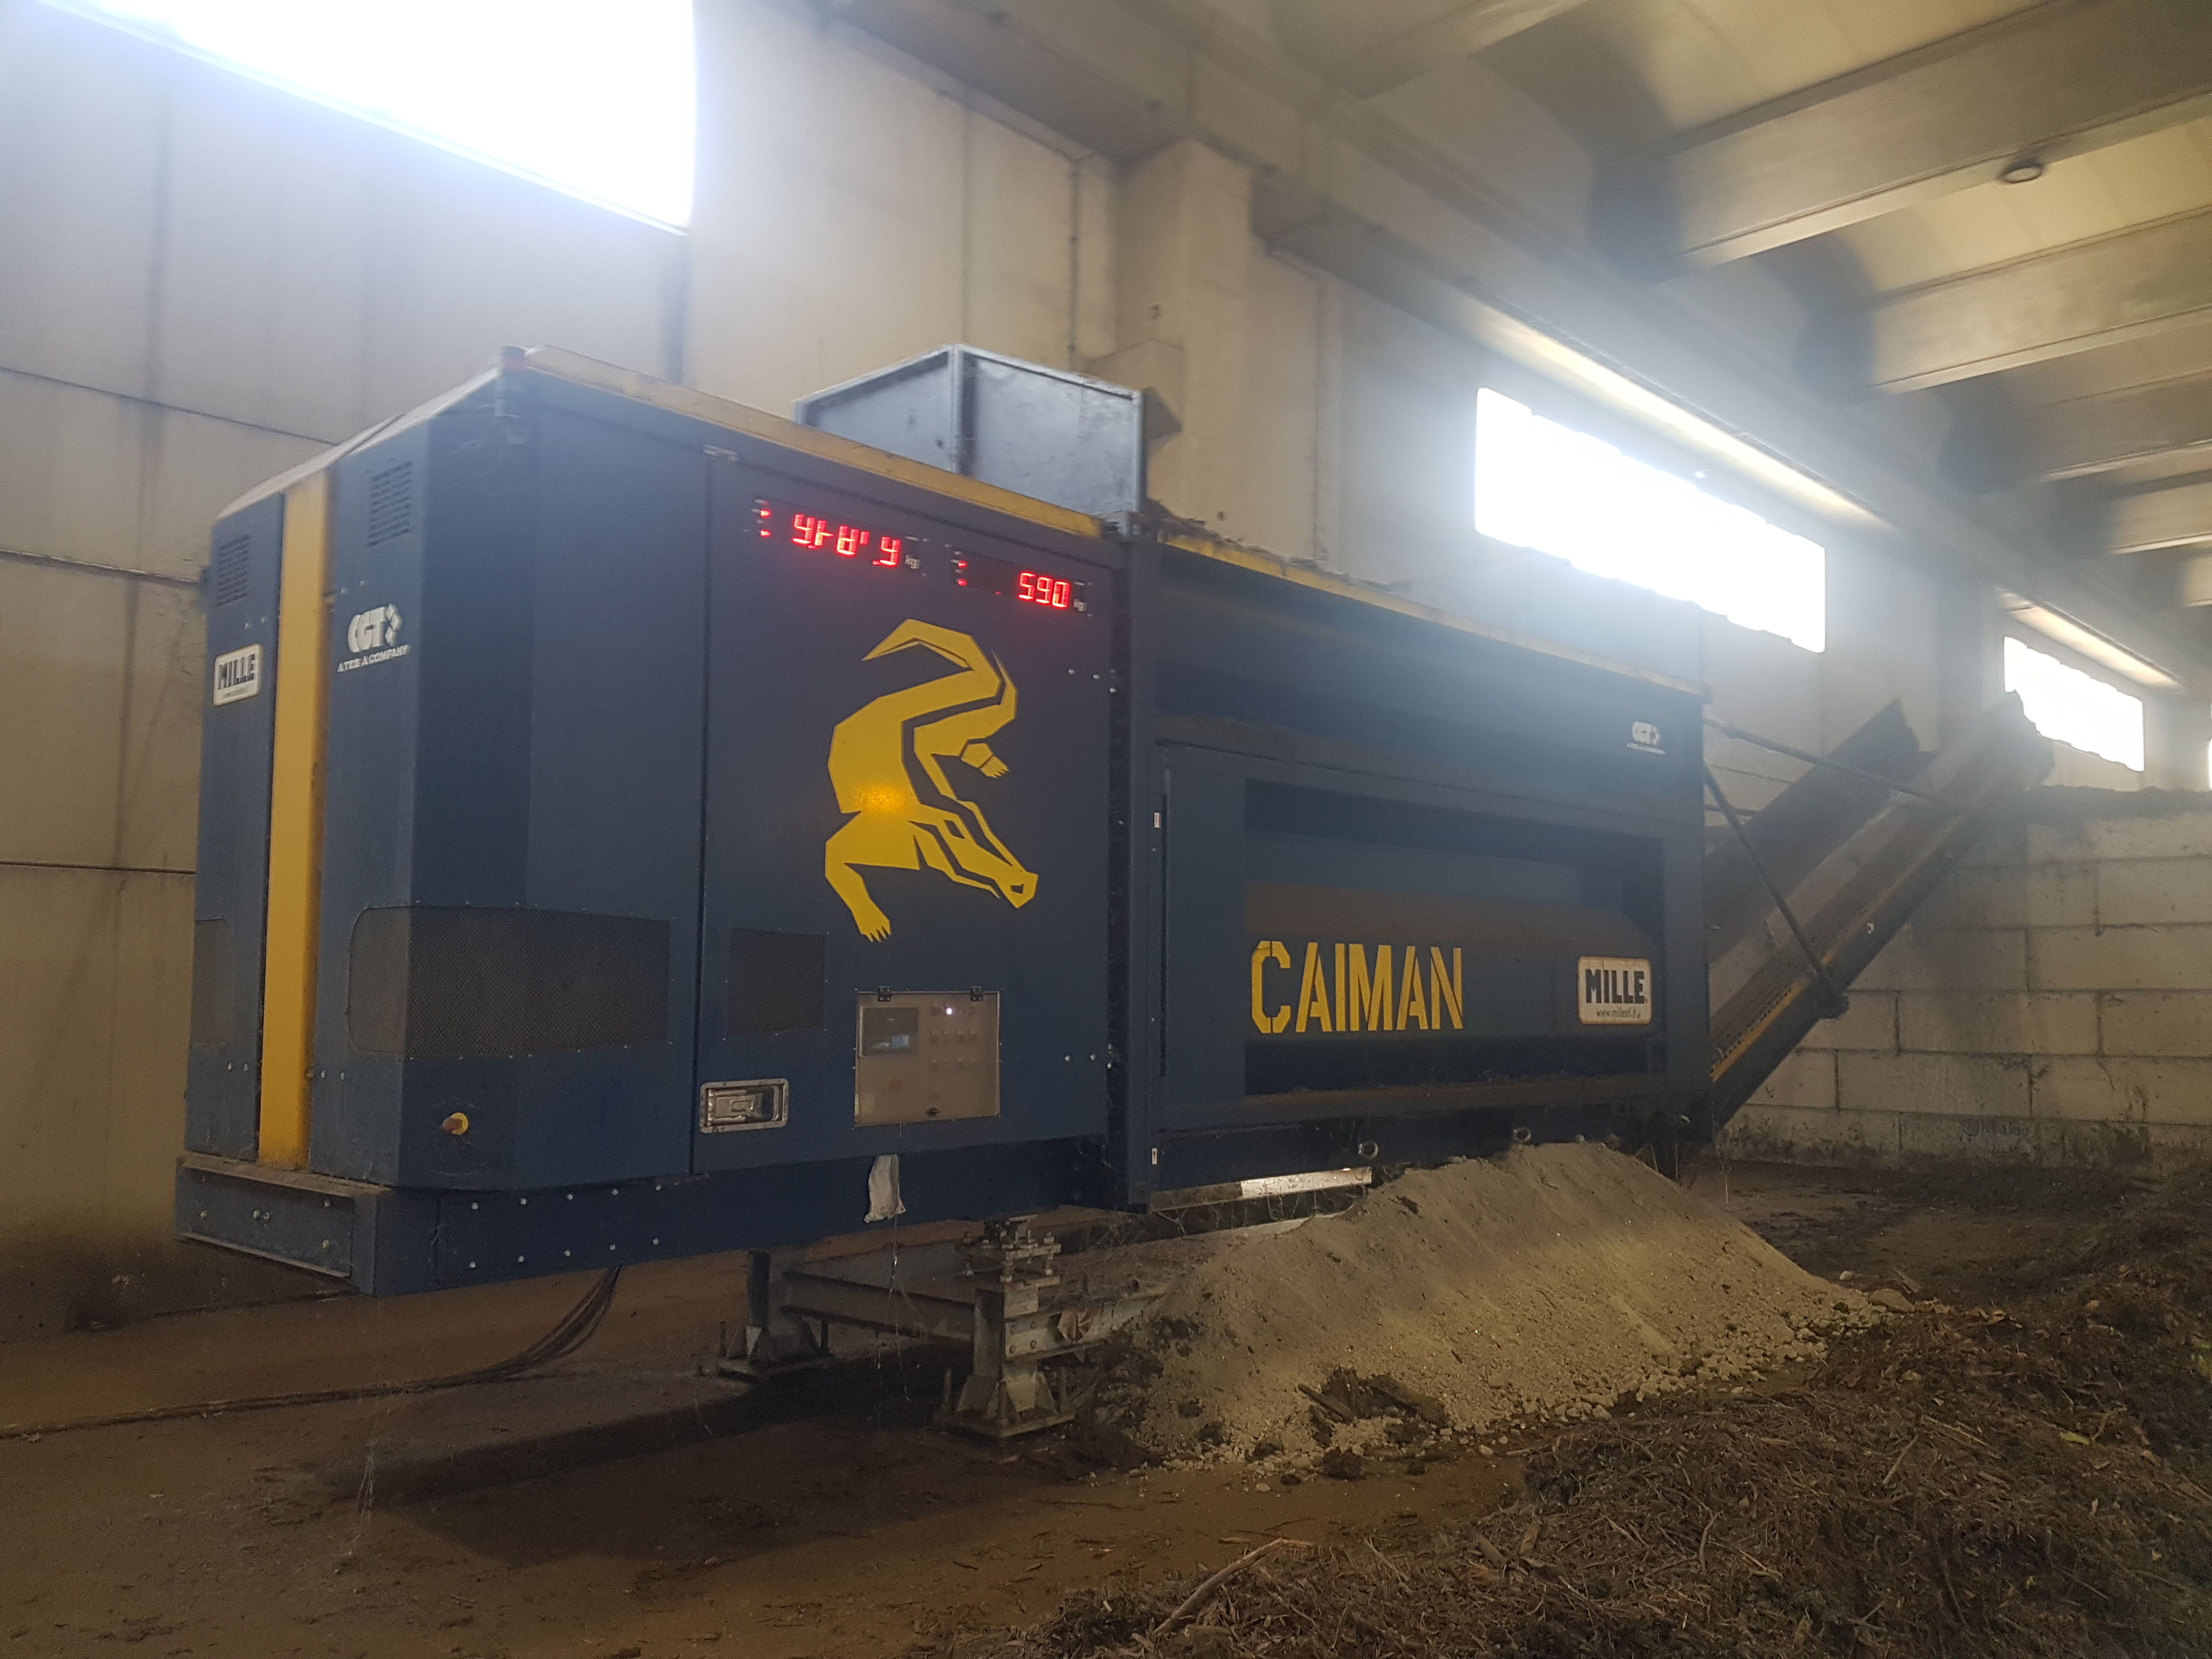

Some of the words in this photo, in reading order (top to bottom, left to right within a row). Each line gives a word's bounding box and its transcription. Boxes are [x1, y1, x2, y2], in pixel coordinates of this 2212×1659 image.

[1019, 572, 1070, 607] 590
[217, 653, 255, 690] MILLE
[368, 644, 410, 663] COMPANY
[1251, 940, 1463, 1033] CAIMAN
[1585, 968, 1645, 1004] MILLE
